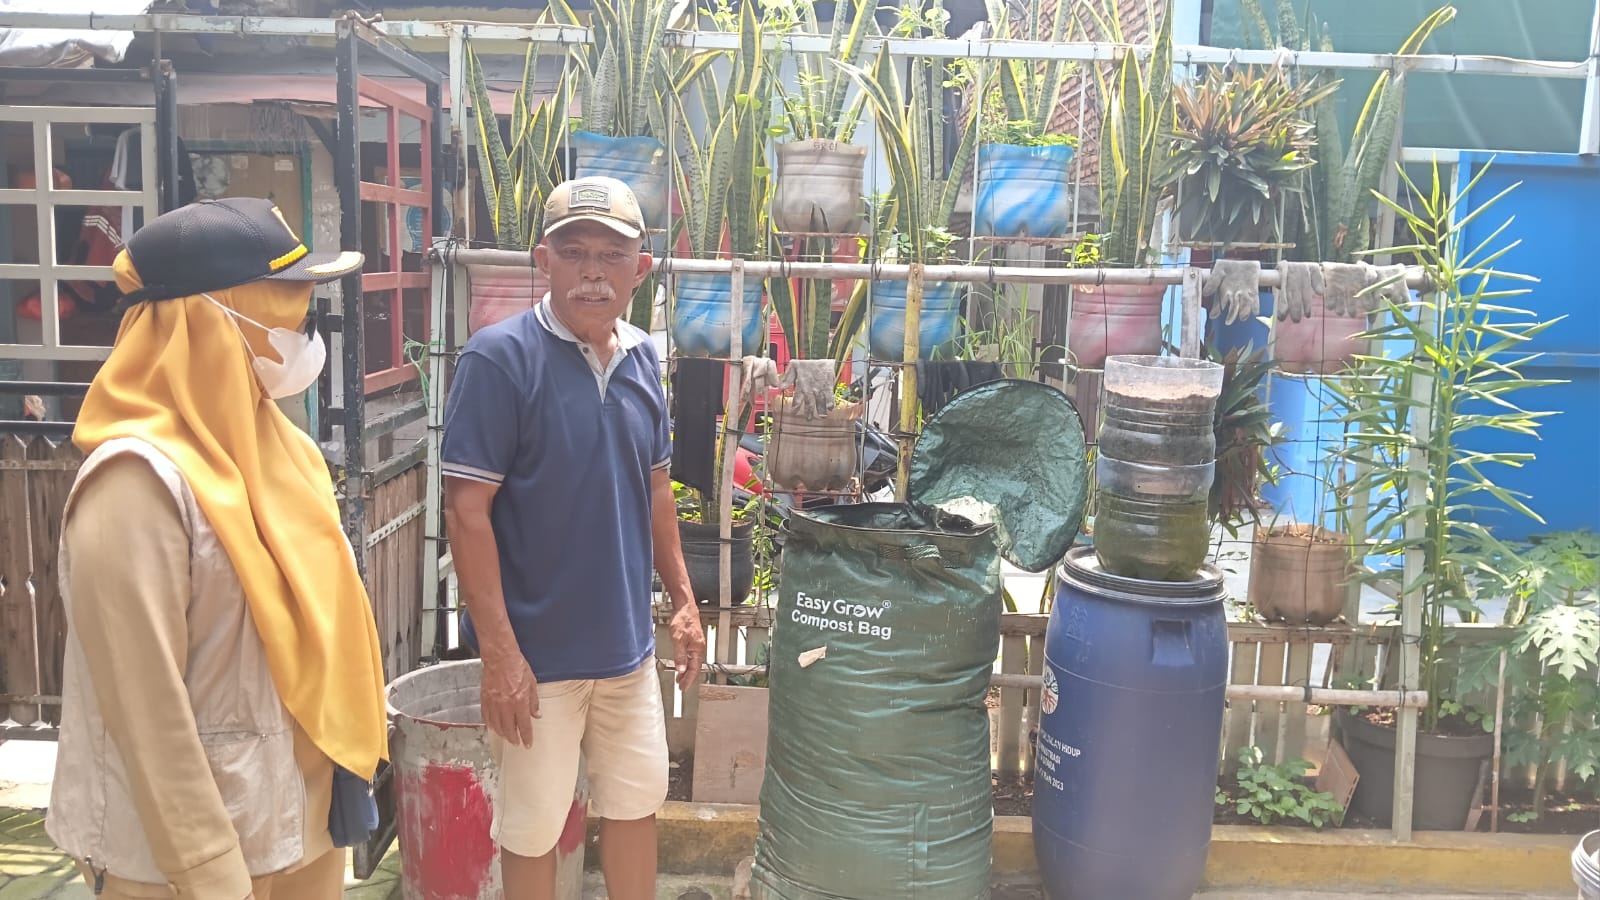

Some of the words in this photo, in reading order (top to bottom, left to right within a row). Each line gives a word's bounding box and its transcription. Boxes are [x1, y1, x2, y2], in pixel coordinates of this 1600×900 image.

[796, 591, 831, 614] Easy
[791, 609, 854, 633] Compost
[858, 621, 892, 640] Bag
